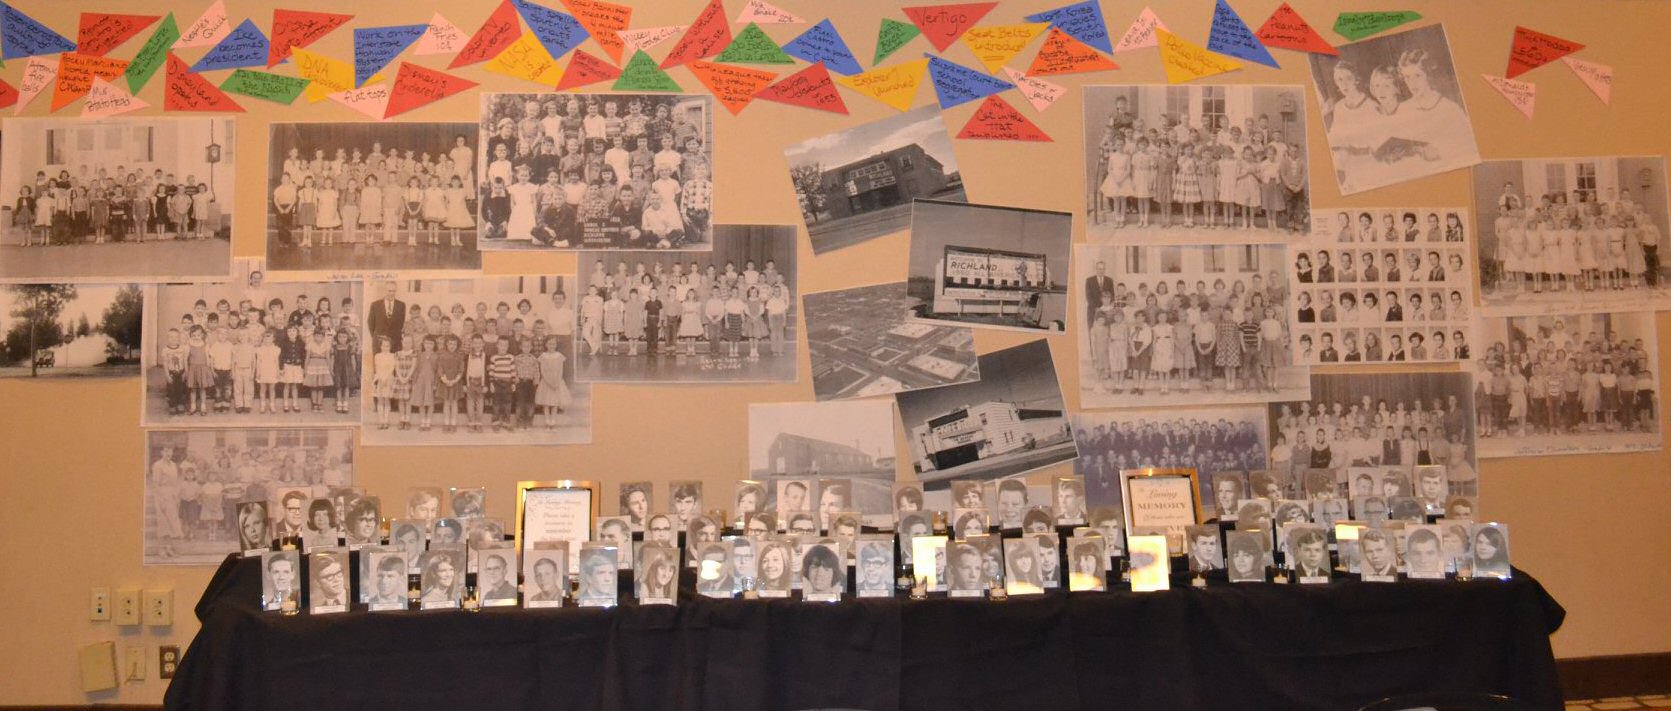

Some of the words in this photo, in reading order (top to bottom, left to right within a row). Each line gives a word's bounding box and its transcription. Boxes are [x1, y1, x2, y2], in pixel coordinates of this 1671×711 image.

[914, 7, 968, 37] Vertigo
[951, 261, 998, 272] RICHLAND
[1137, 502, 1187, 511] MEMORY
